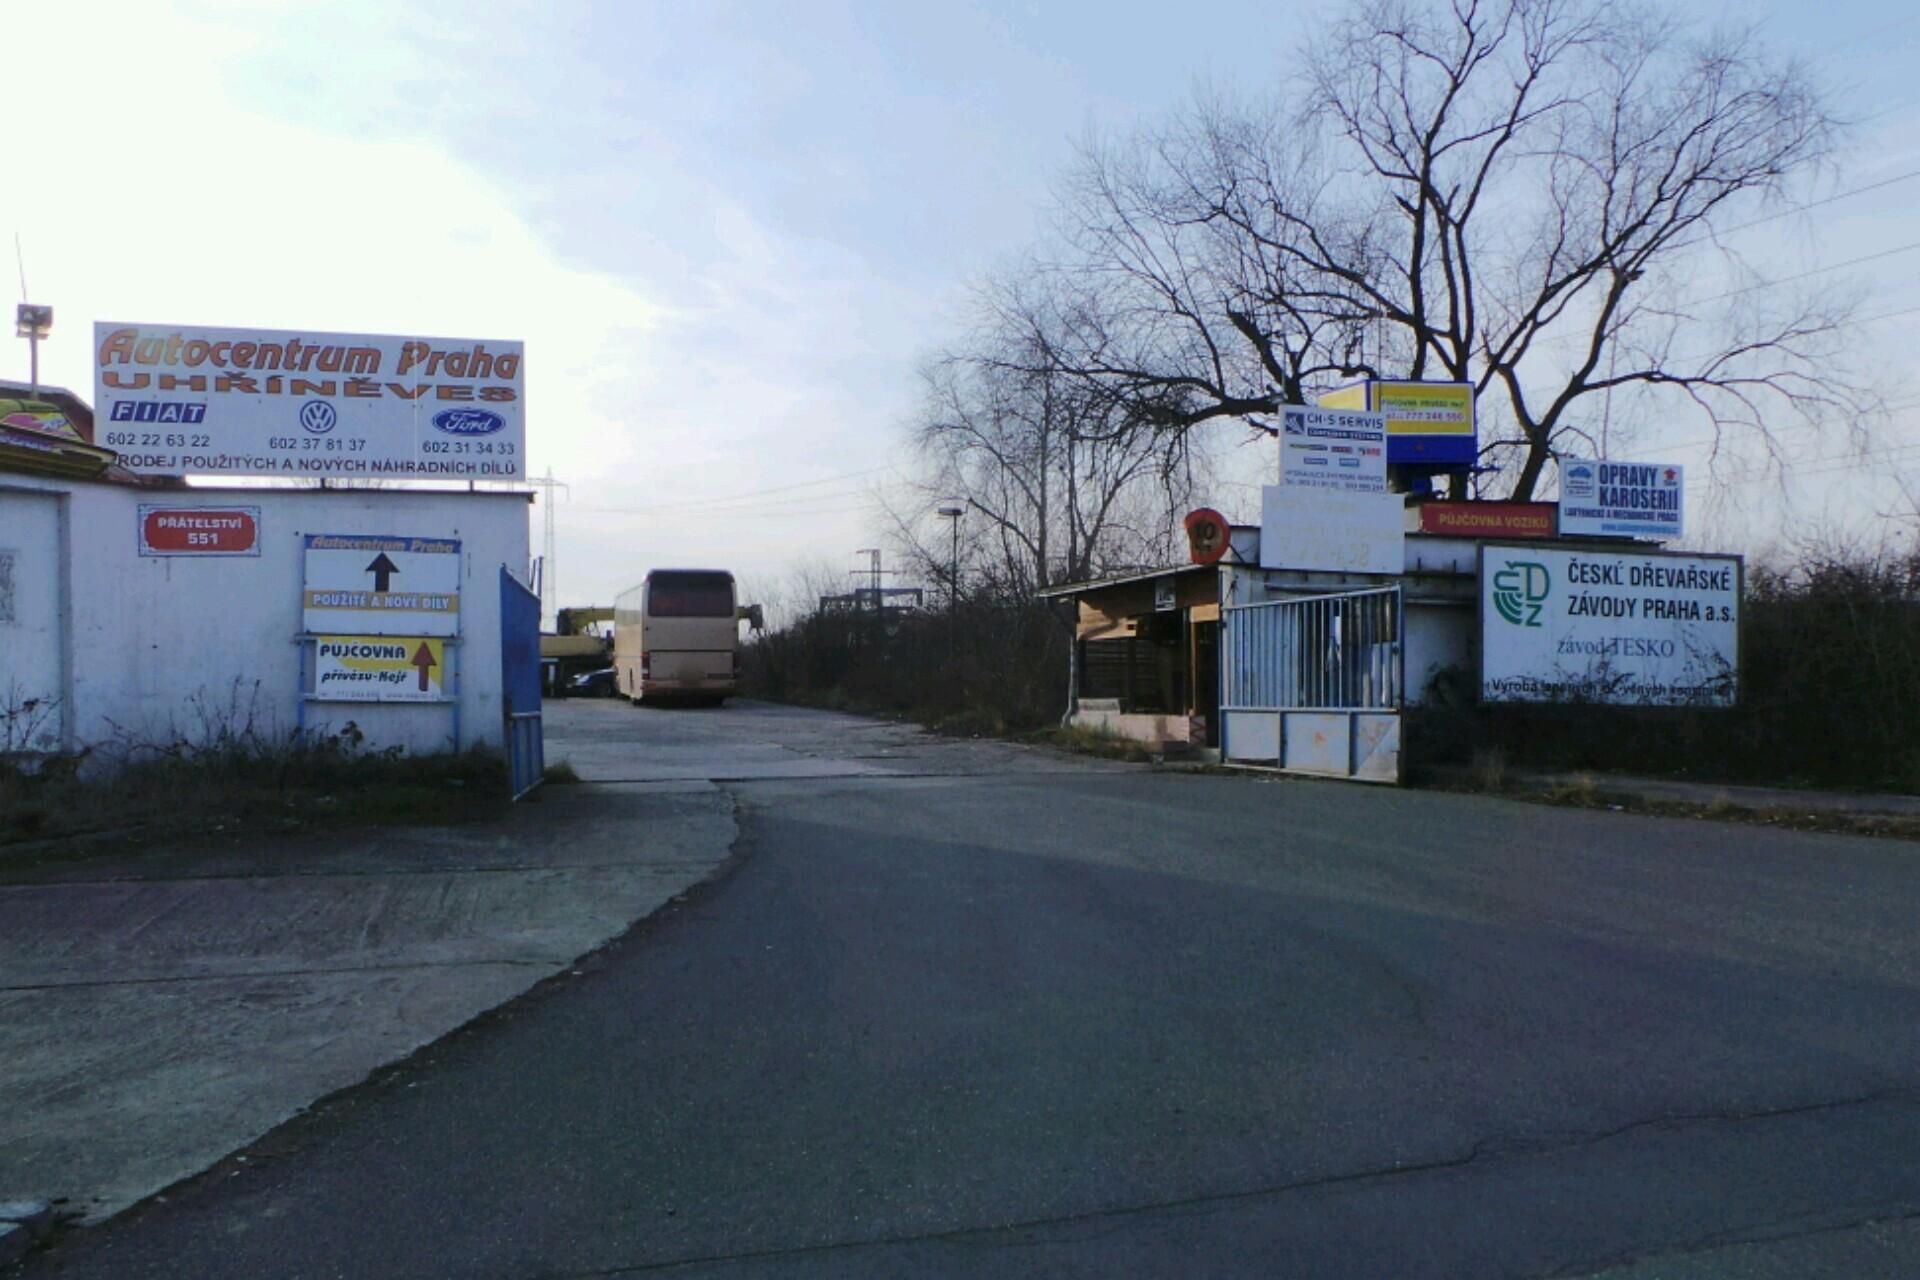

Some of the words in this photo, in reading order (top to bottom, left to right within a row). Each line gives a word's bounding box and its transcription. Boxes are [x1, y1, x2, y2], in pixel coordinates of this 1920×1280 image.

[100, 328, 382, 373] Autocentrum
[396, 341, 520, 379] Praha
[111, 400, 207, 424] FIAT
[1339, 416, 1384, 429] SERVIS
[107, 432, 135, 446] 602
[141, 434, 160, 447] 22
[167, 434, 185, 447] 63
[191, 436, 210, 448] 22
[269, 438, 297, 450] 602
[302, 439, 320, 450] 37
[327, 439, 342, 451] 81
[349, 440, 366, 452] 37
[422, 440, 449, 454] 602
[455, 441, 470, 454] 31
[476, 441, 492, 455] 34
[497, 442, 515, 455] 33
[182, 453, 277, 470] POUŽITÝCH
[282, 459, 293, 470] A
[299, 456, 366, 472] NOVÝCH
[371, 457, 476, 474] NÁHRADNÍCH
[1599, 464, 1658, 487] OPRAVY
[1599, 486, 1679, 511] KAROSERIÍ
[187, 532, 218, 545] 551
[311, 536, 406, 551] Autocentrum
[410, 539, 454, 554] Praha
[1630, 560, 1731, 592] DŘEVAŘSKÉ
[370, 596, 380, 608] A
[384, 594, 417, 609] NOVÉ
[1568, 590, 1637, 618] ZÁVODY
[1643, 598, 1700, 621] PRAHA
[1706, 606, 1736, 623] a.s.
[320, 640, 406, 659] PŮJČOVNA
[1611, 637, 1675, 658] TESKO
